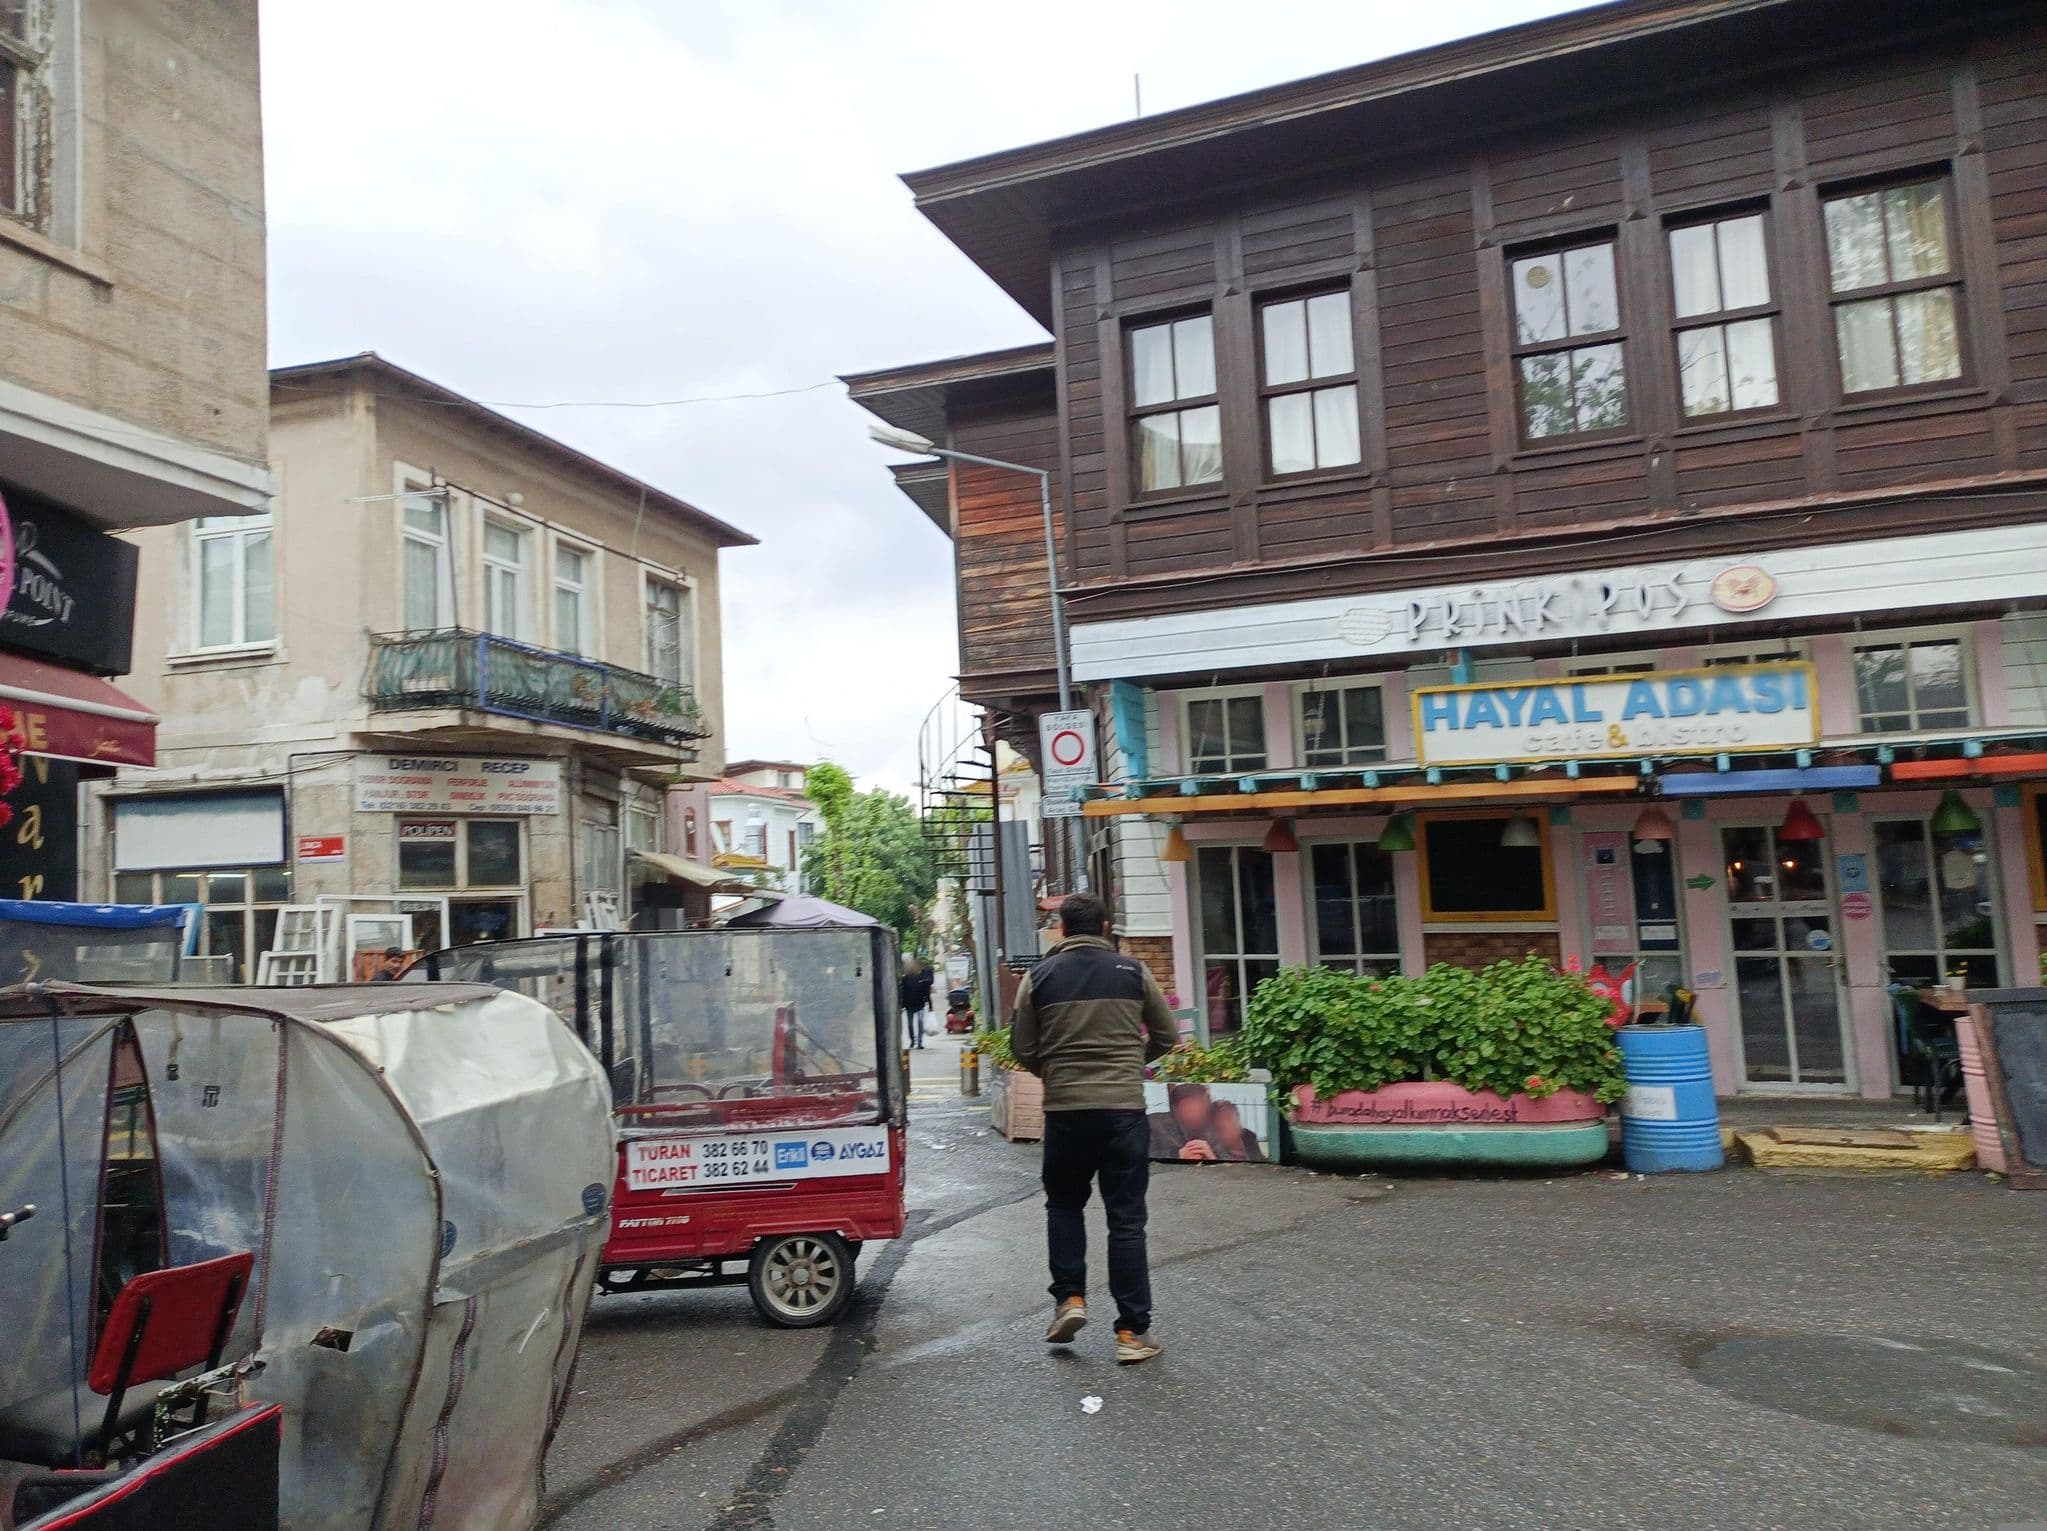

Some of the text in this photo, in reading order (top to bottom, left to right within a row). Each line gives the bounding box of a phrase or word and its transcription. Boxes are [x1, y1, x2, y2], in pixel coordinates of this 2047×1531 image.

[1424, 671, 1808, 731] HAYAL ADASI
[1522, 720, 1748, 753] cafe & bistro
[481, 761, 531, 774] RECEP
[637, 1143, 691, 1162] TURAN
[703, 1142, 728, 1158] 382
[732, 1141, 749, 1157] 66
[751, 1140, 769, 1156] 70
[838, 1141, 885, 1161] AYGAZ
[703, 1162, 728, 1178] 382
[732, 1161, 749, 1176] 62
[752, 1159, 769, 1174] 44
